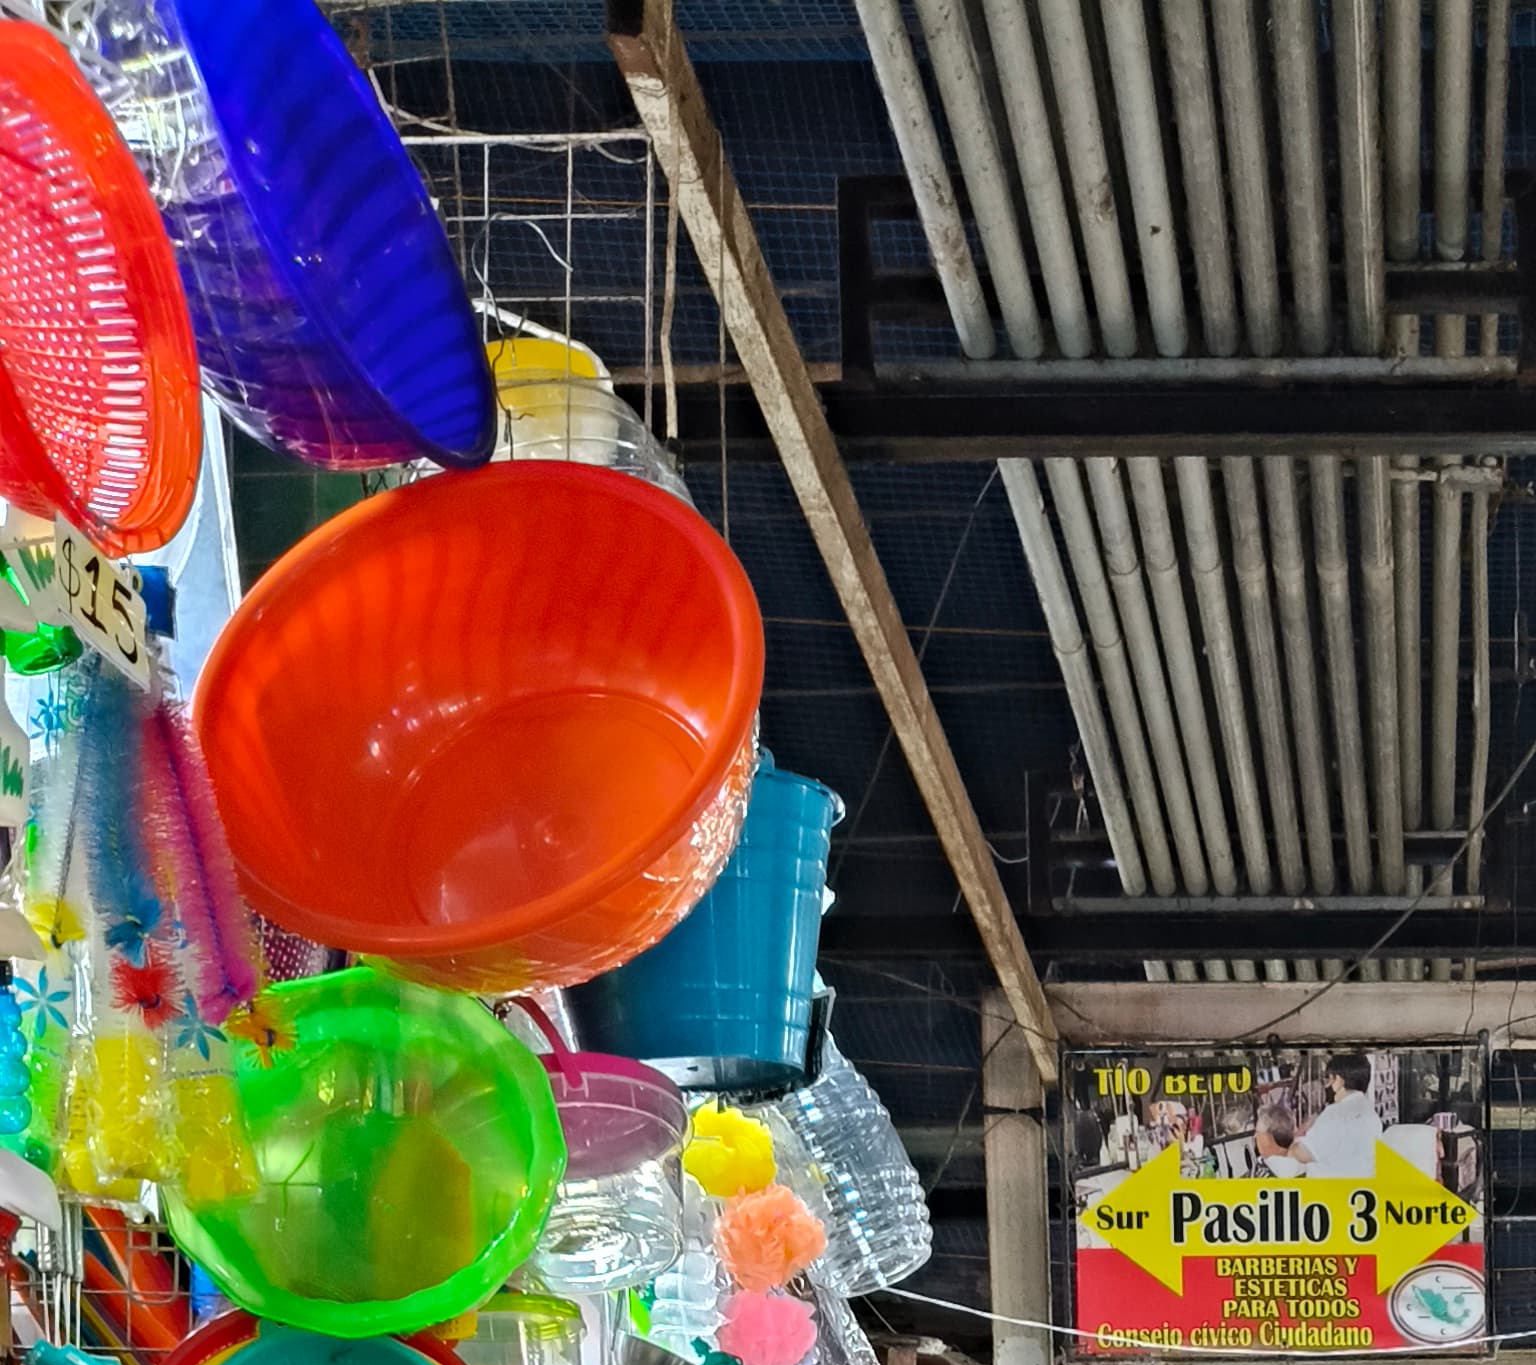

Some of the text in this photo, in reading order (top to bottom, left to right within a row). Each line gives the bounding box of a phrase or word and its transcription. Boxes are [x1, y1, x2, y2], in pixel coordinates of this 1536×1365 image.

[1096, 1189, 1468, 1243] Sur Pasillo 3 Norte
[1216, 1257, 1359, 1278] BARBERIAS Y
[1234, 1277, 1348, 1298] ESTETICAS
[1222, 1298, 1361, 1319] PARA TODOS
[1096, 1321, 1184, 1350] Consejo
[1257, 1320, 1374, 1349] Ciudadano
